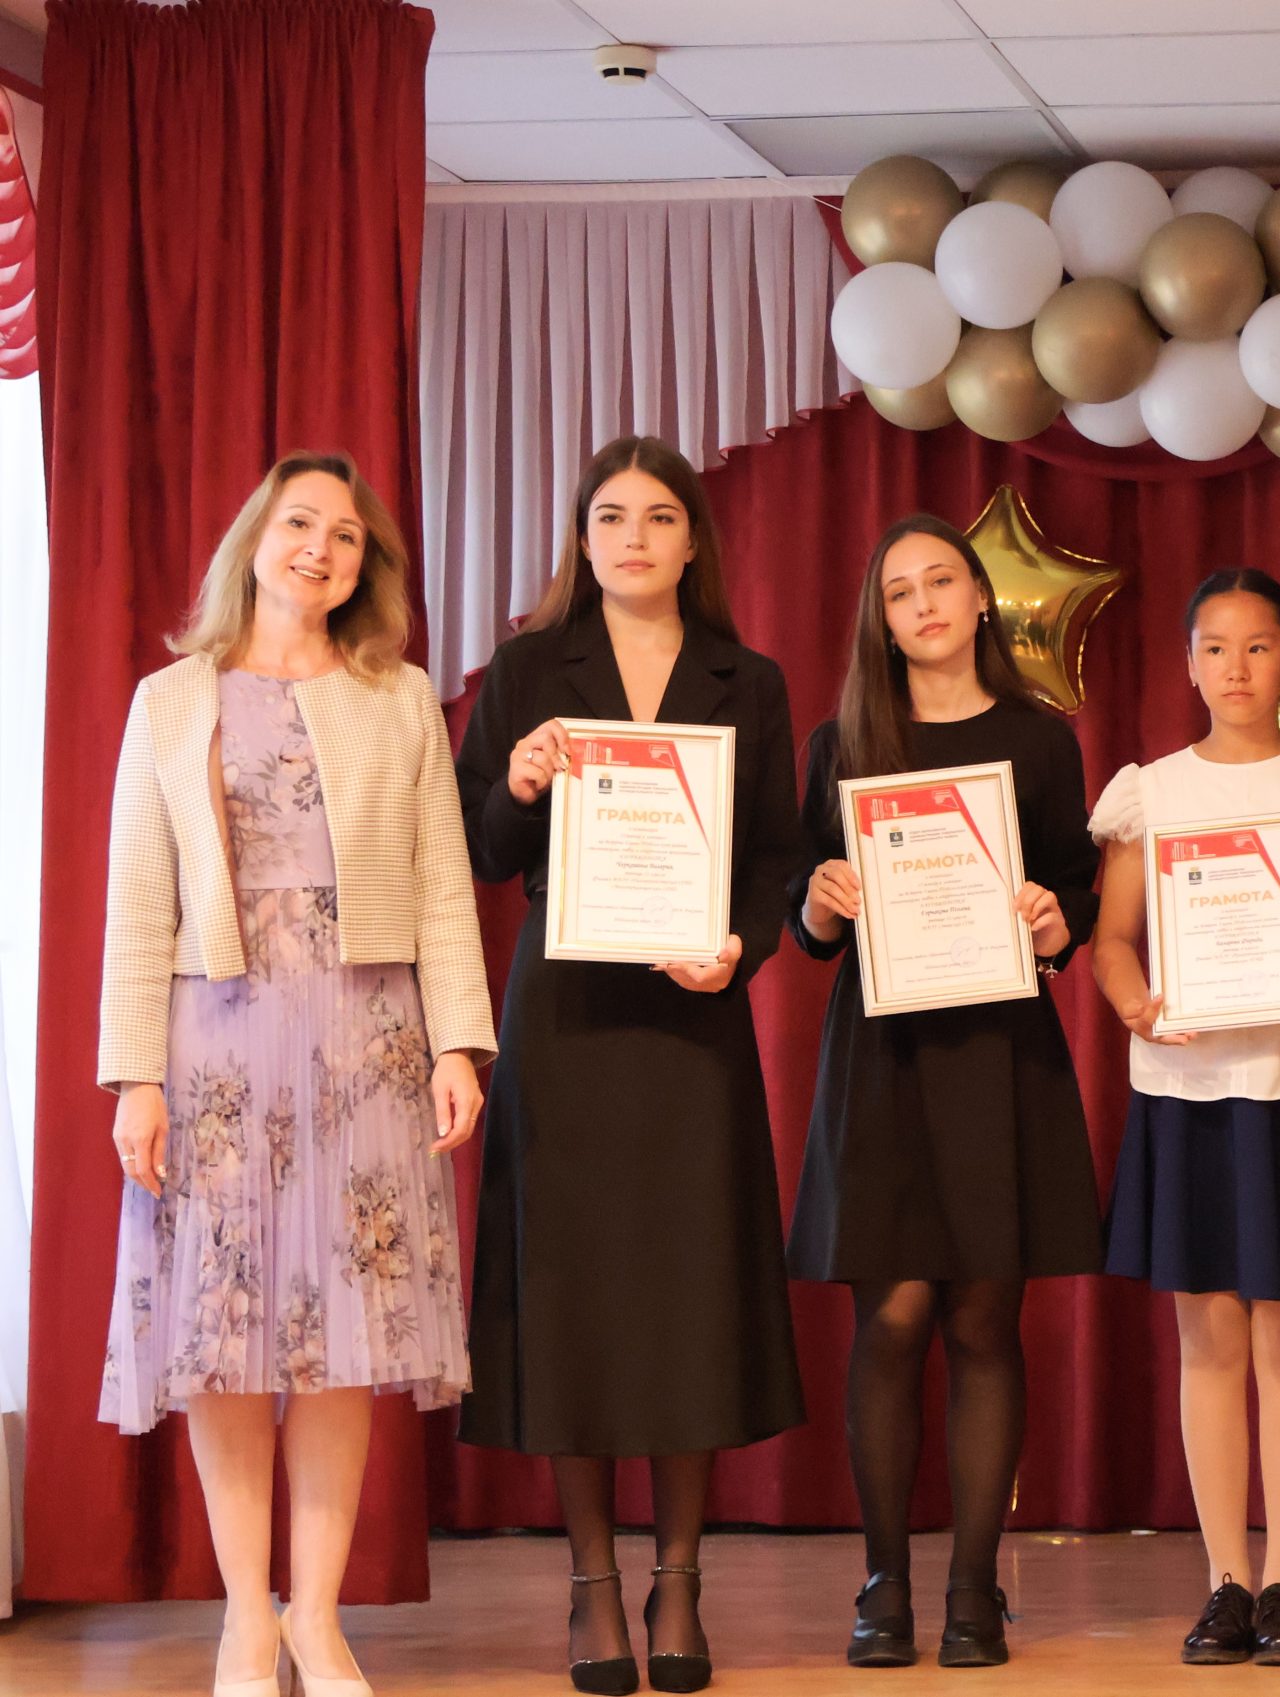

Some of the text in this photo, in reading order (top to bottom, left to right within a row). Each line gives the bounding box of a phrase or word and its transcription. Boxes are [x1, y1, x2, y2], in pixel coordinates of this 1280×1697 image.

[597, 808, 685, 824] ГРАМОТА
[893, 853, 978, 873] ГРАМОТА
[1190, 890, 1273, 908] ГРАМОТА
